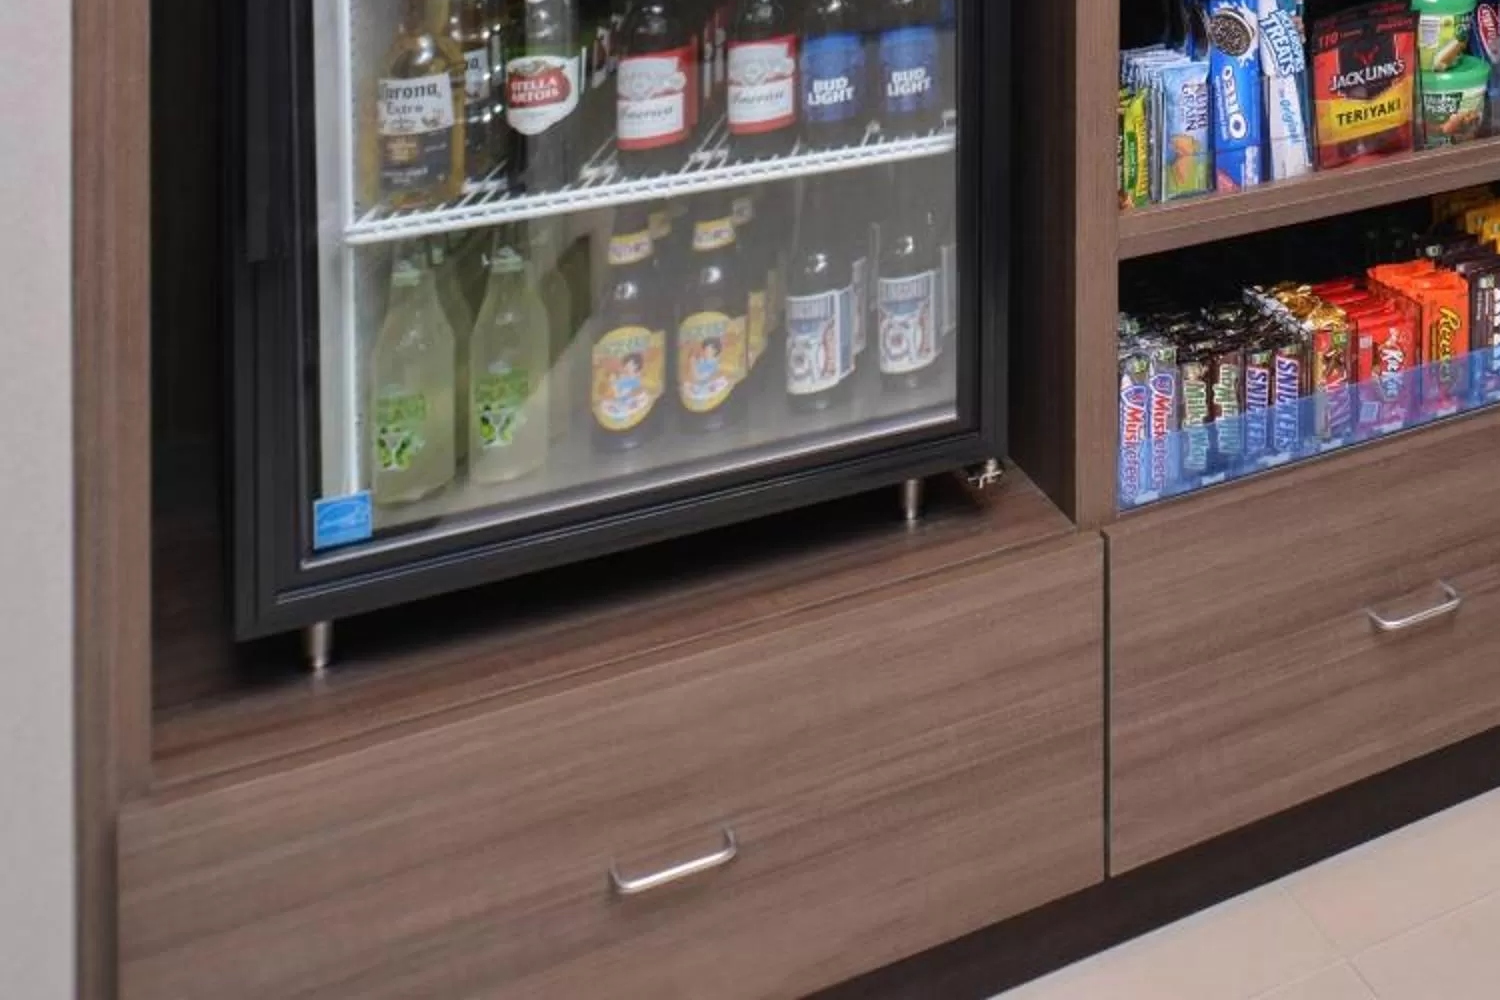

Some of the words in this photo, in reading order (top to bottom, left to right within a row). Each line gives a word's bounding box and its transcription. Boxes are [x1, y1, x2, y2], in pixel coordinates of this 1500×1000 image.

[1259, 11, 1295, 78] TREATS
[812, 76, 849, 92] BUD
[1329, 70, 1366, 92] JACK
[807, 87, 855, 106] LIGHT
[1222, 64, 1248, 140] OREO
[1335, 97, 1402, 127] TERIYAKI
[1274, 355, 1300, 450] SNICKERS
